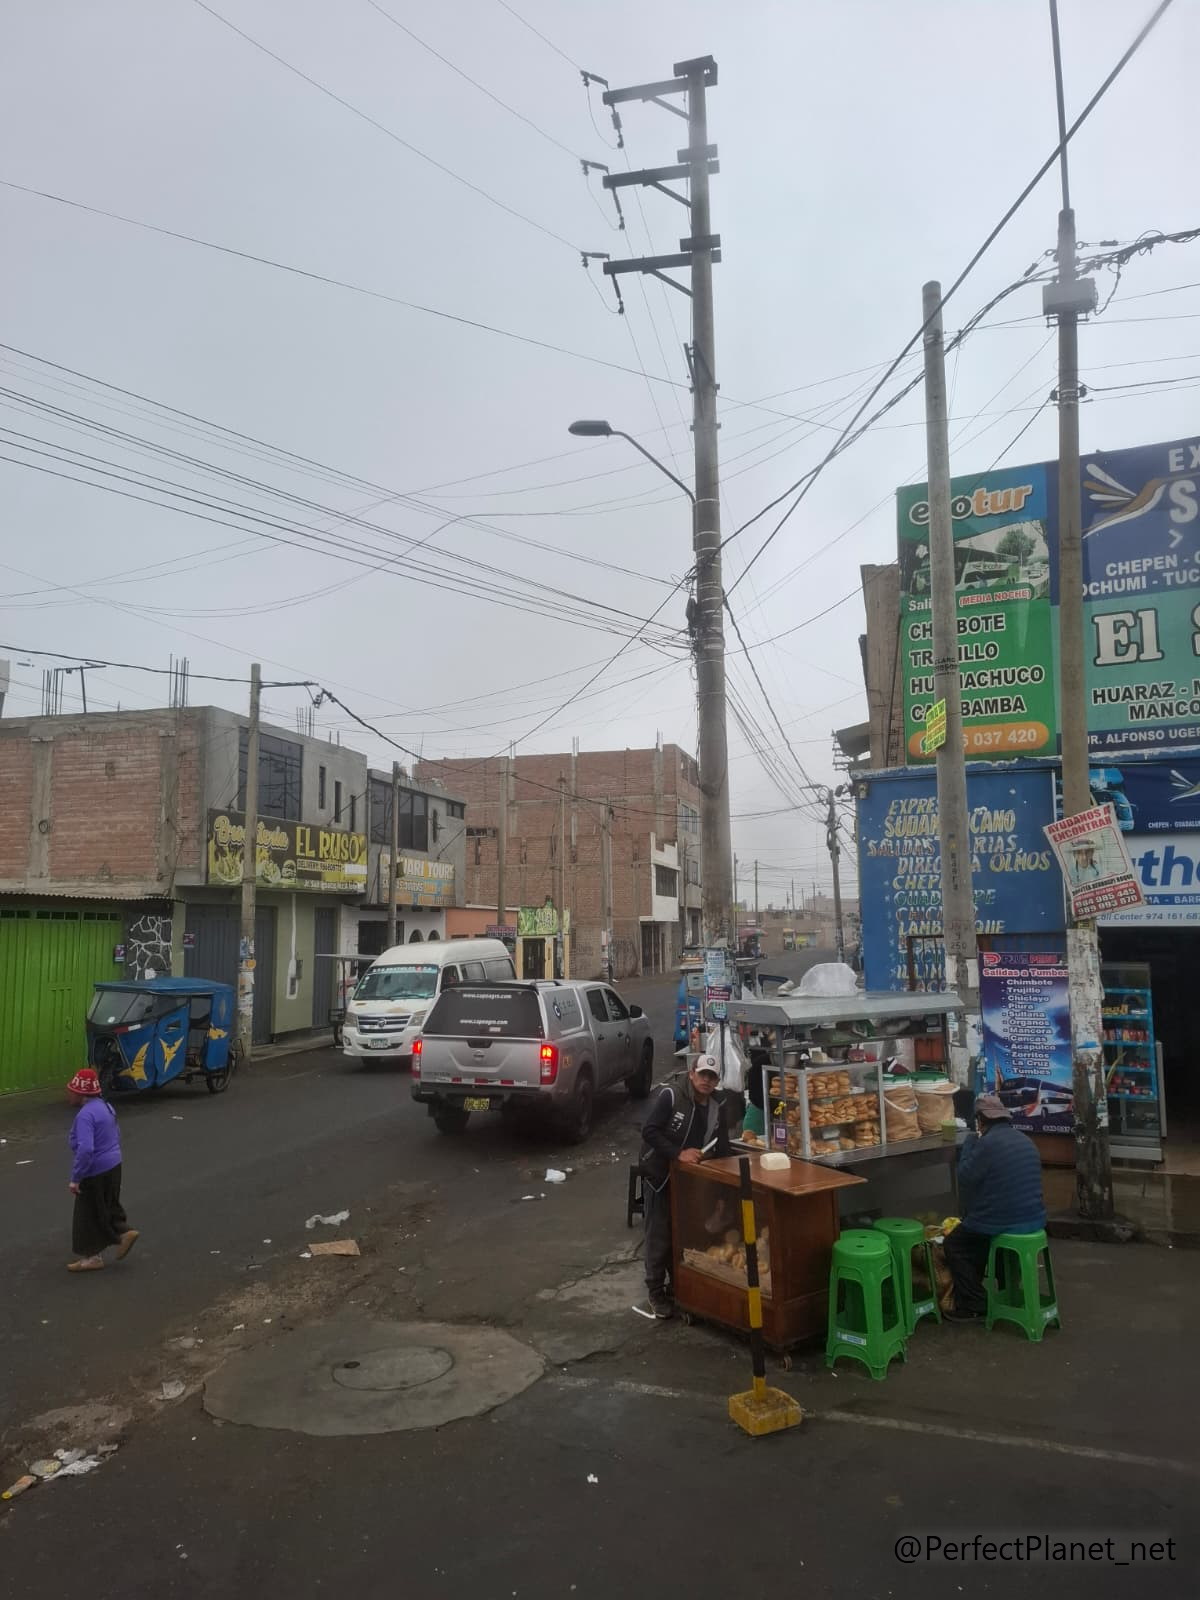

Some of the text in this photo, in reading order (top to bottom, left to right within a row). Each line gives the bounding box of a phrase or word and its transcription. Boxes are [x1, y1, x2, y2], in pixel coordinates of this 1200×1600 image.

[909, 485, 1033, 525] eotur
[1106, 554, 1178, 577] CHEPEN
[908, 599, 932, 612] Sali
[910, 614, 1005, 640] CHBOTE
[1092, 608, 1164, 667] El
[909, 641, 998, 668] TRILLO
[910, 665, 1045, 695] HUACHUCO
[1092, 682, 1175, 705] HUARAZ
[911, 695, 1027, 722] CABAMBA
[974, 731, 1002, 746] 037
[1007, 728, 1037, 744] 420
[1106, 729, 1165, 744] ALFONSO
[884, 809, 1016, 837] SUDAMICANO
[1048, 810, 1101, 835] AYUDANOS
[1052, 816, 1113, 844] ENCONTRAR
[296, 826, 315, 857] EL
[319, 830, 359, 862] RUSO
[897, 856, 940, 874] DIREC
[989, 852, 1051, 872] OLMOS
[1132, 846, 1200, 886] th
[892, 876, 942, 890] CHEP
[893, 890, 996, 906] GUADPE
[899, 919, 1005, 936] LAMBQUE
[1146, 912, 1163, 920] 974
[982, 968, 1069, 977] Salidas a Tumbes
[1007, 987, 1041, 995] Trujillo
[1008, 995, 1050, 1003] Chiclayo
[1010, 1043, 1056, 1051] Acapulco
